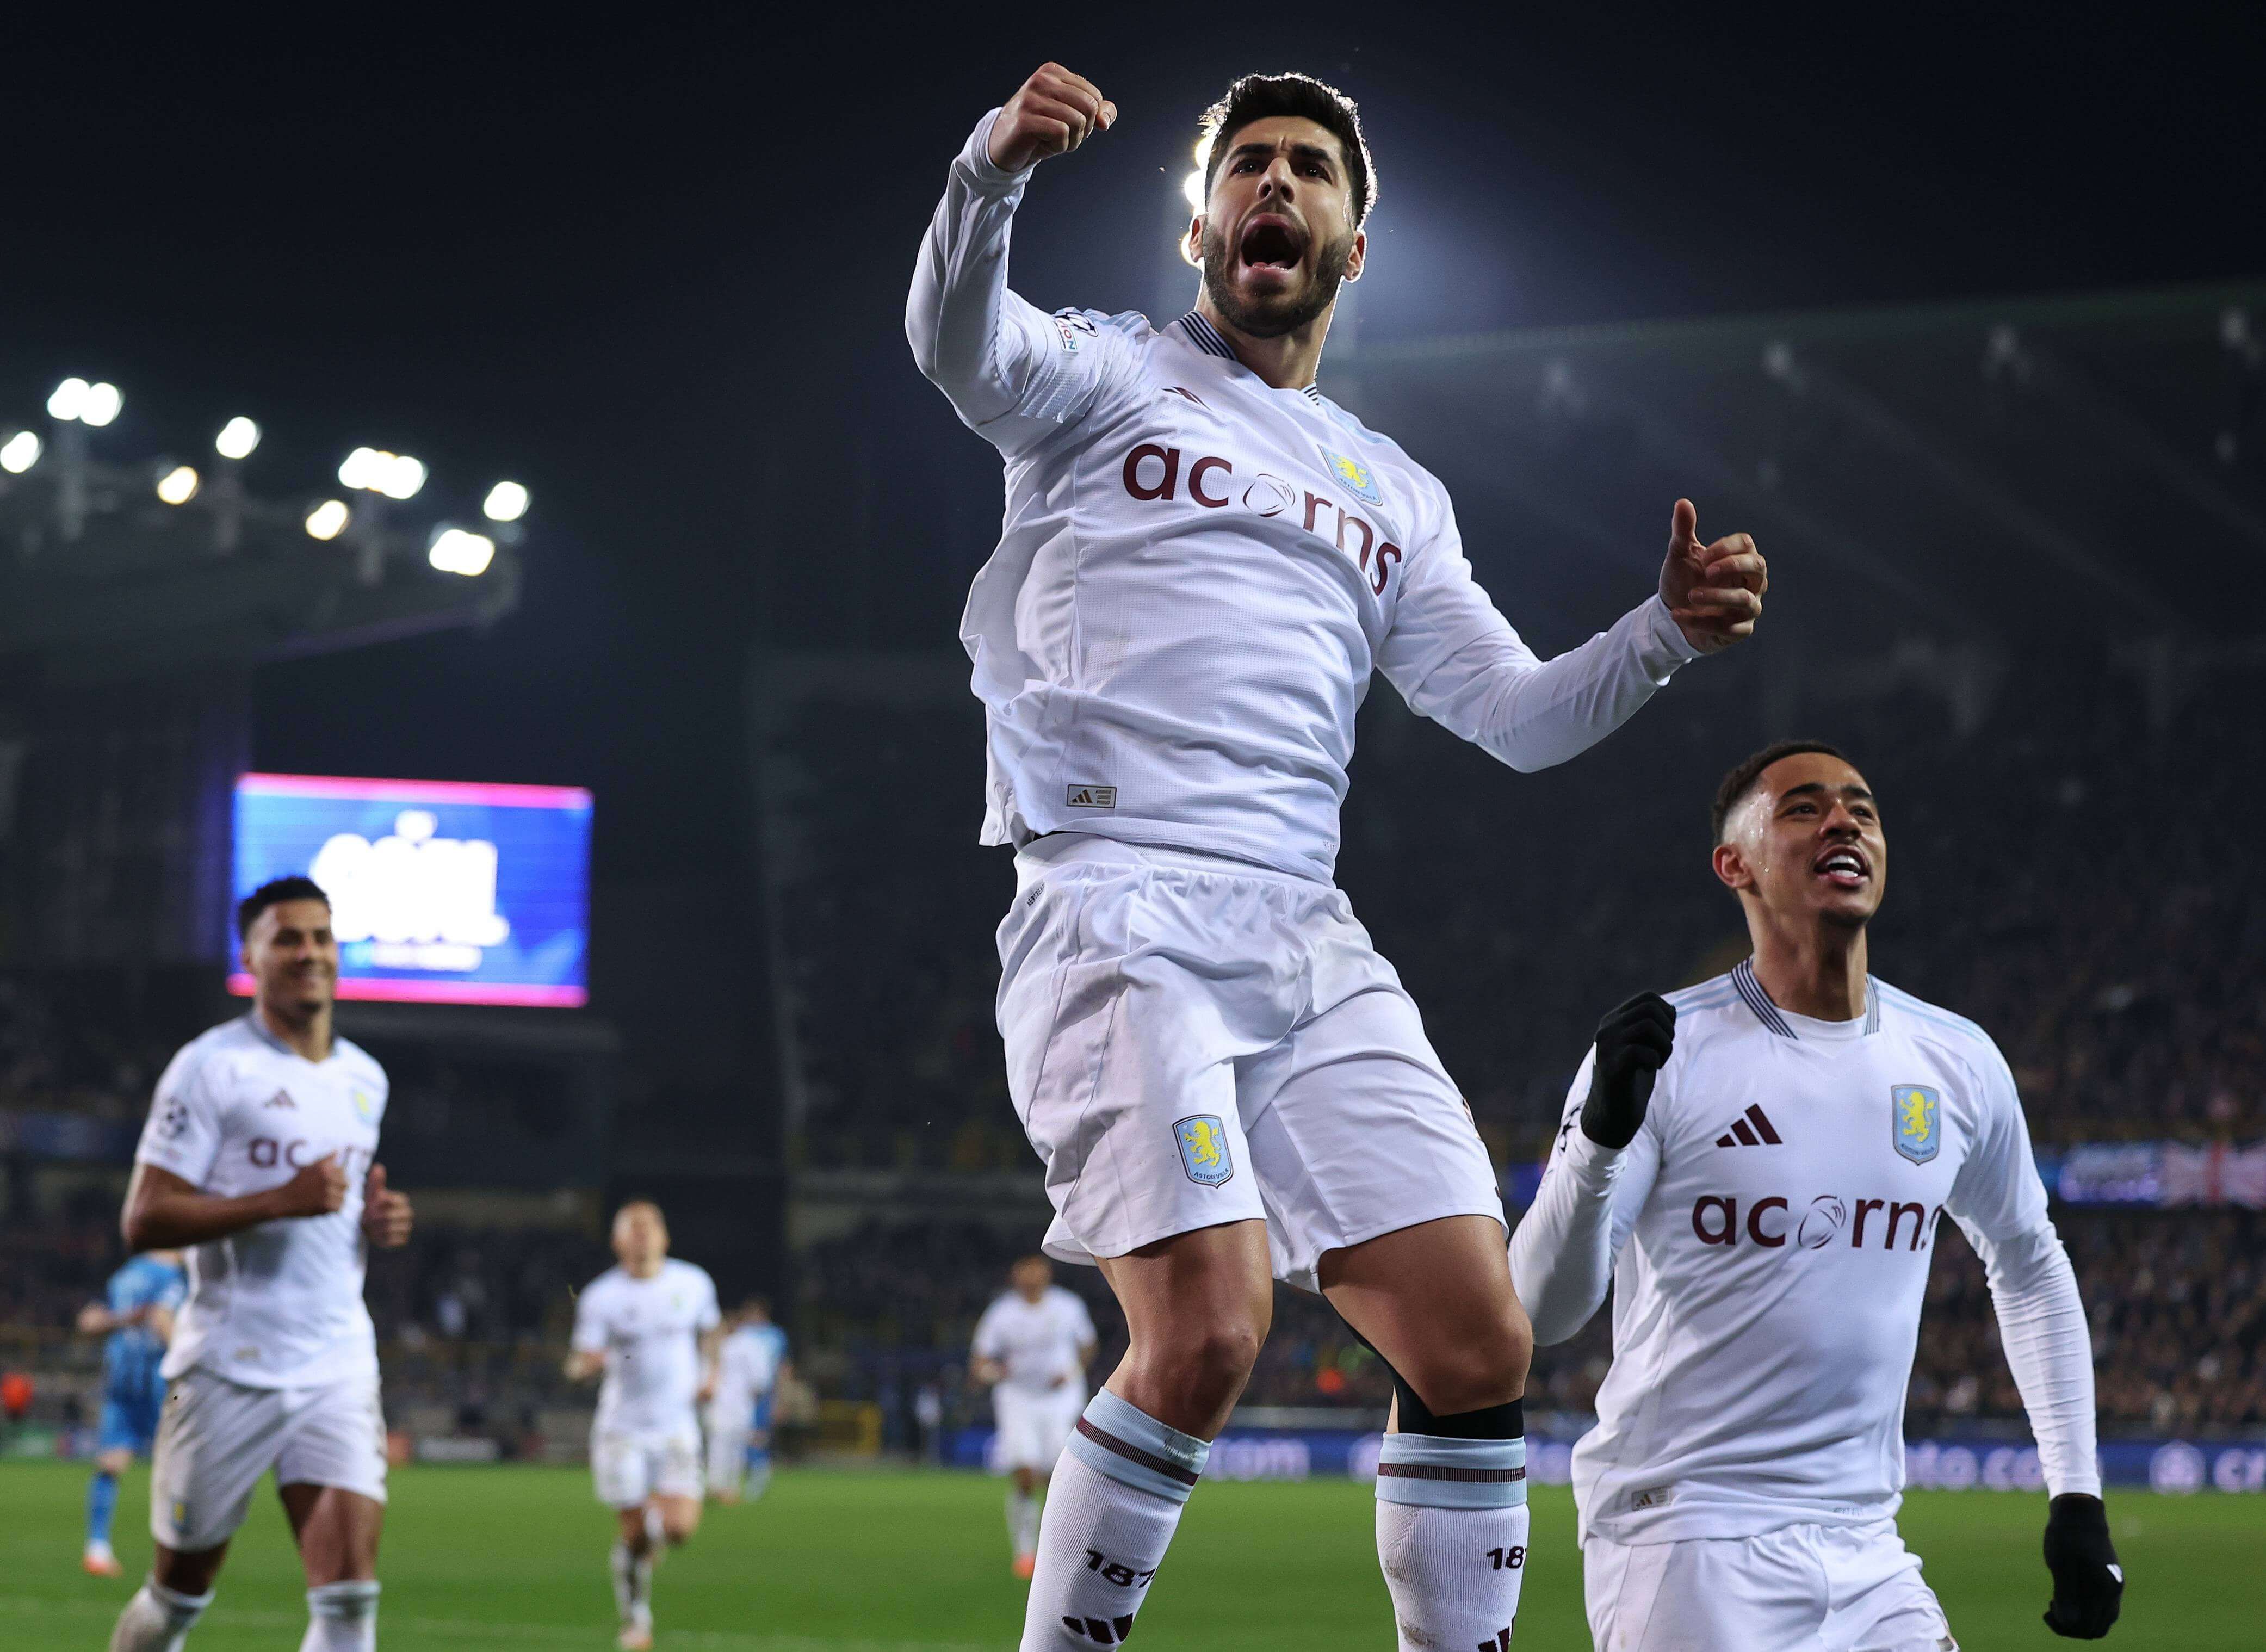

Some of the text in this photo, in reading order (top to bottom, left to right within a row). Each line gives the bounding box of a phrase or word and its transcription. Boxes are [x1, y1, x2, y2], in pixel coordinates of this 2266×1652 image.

[1123, 443, 1402, 596] acorns
[1086, 1549, 1156, 1588] 187
[1487, 1546, 1527, 1570] 18
